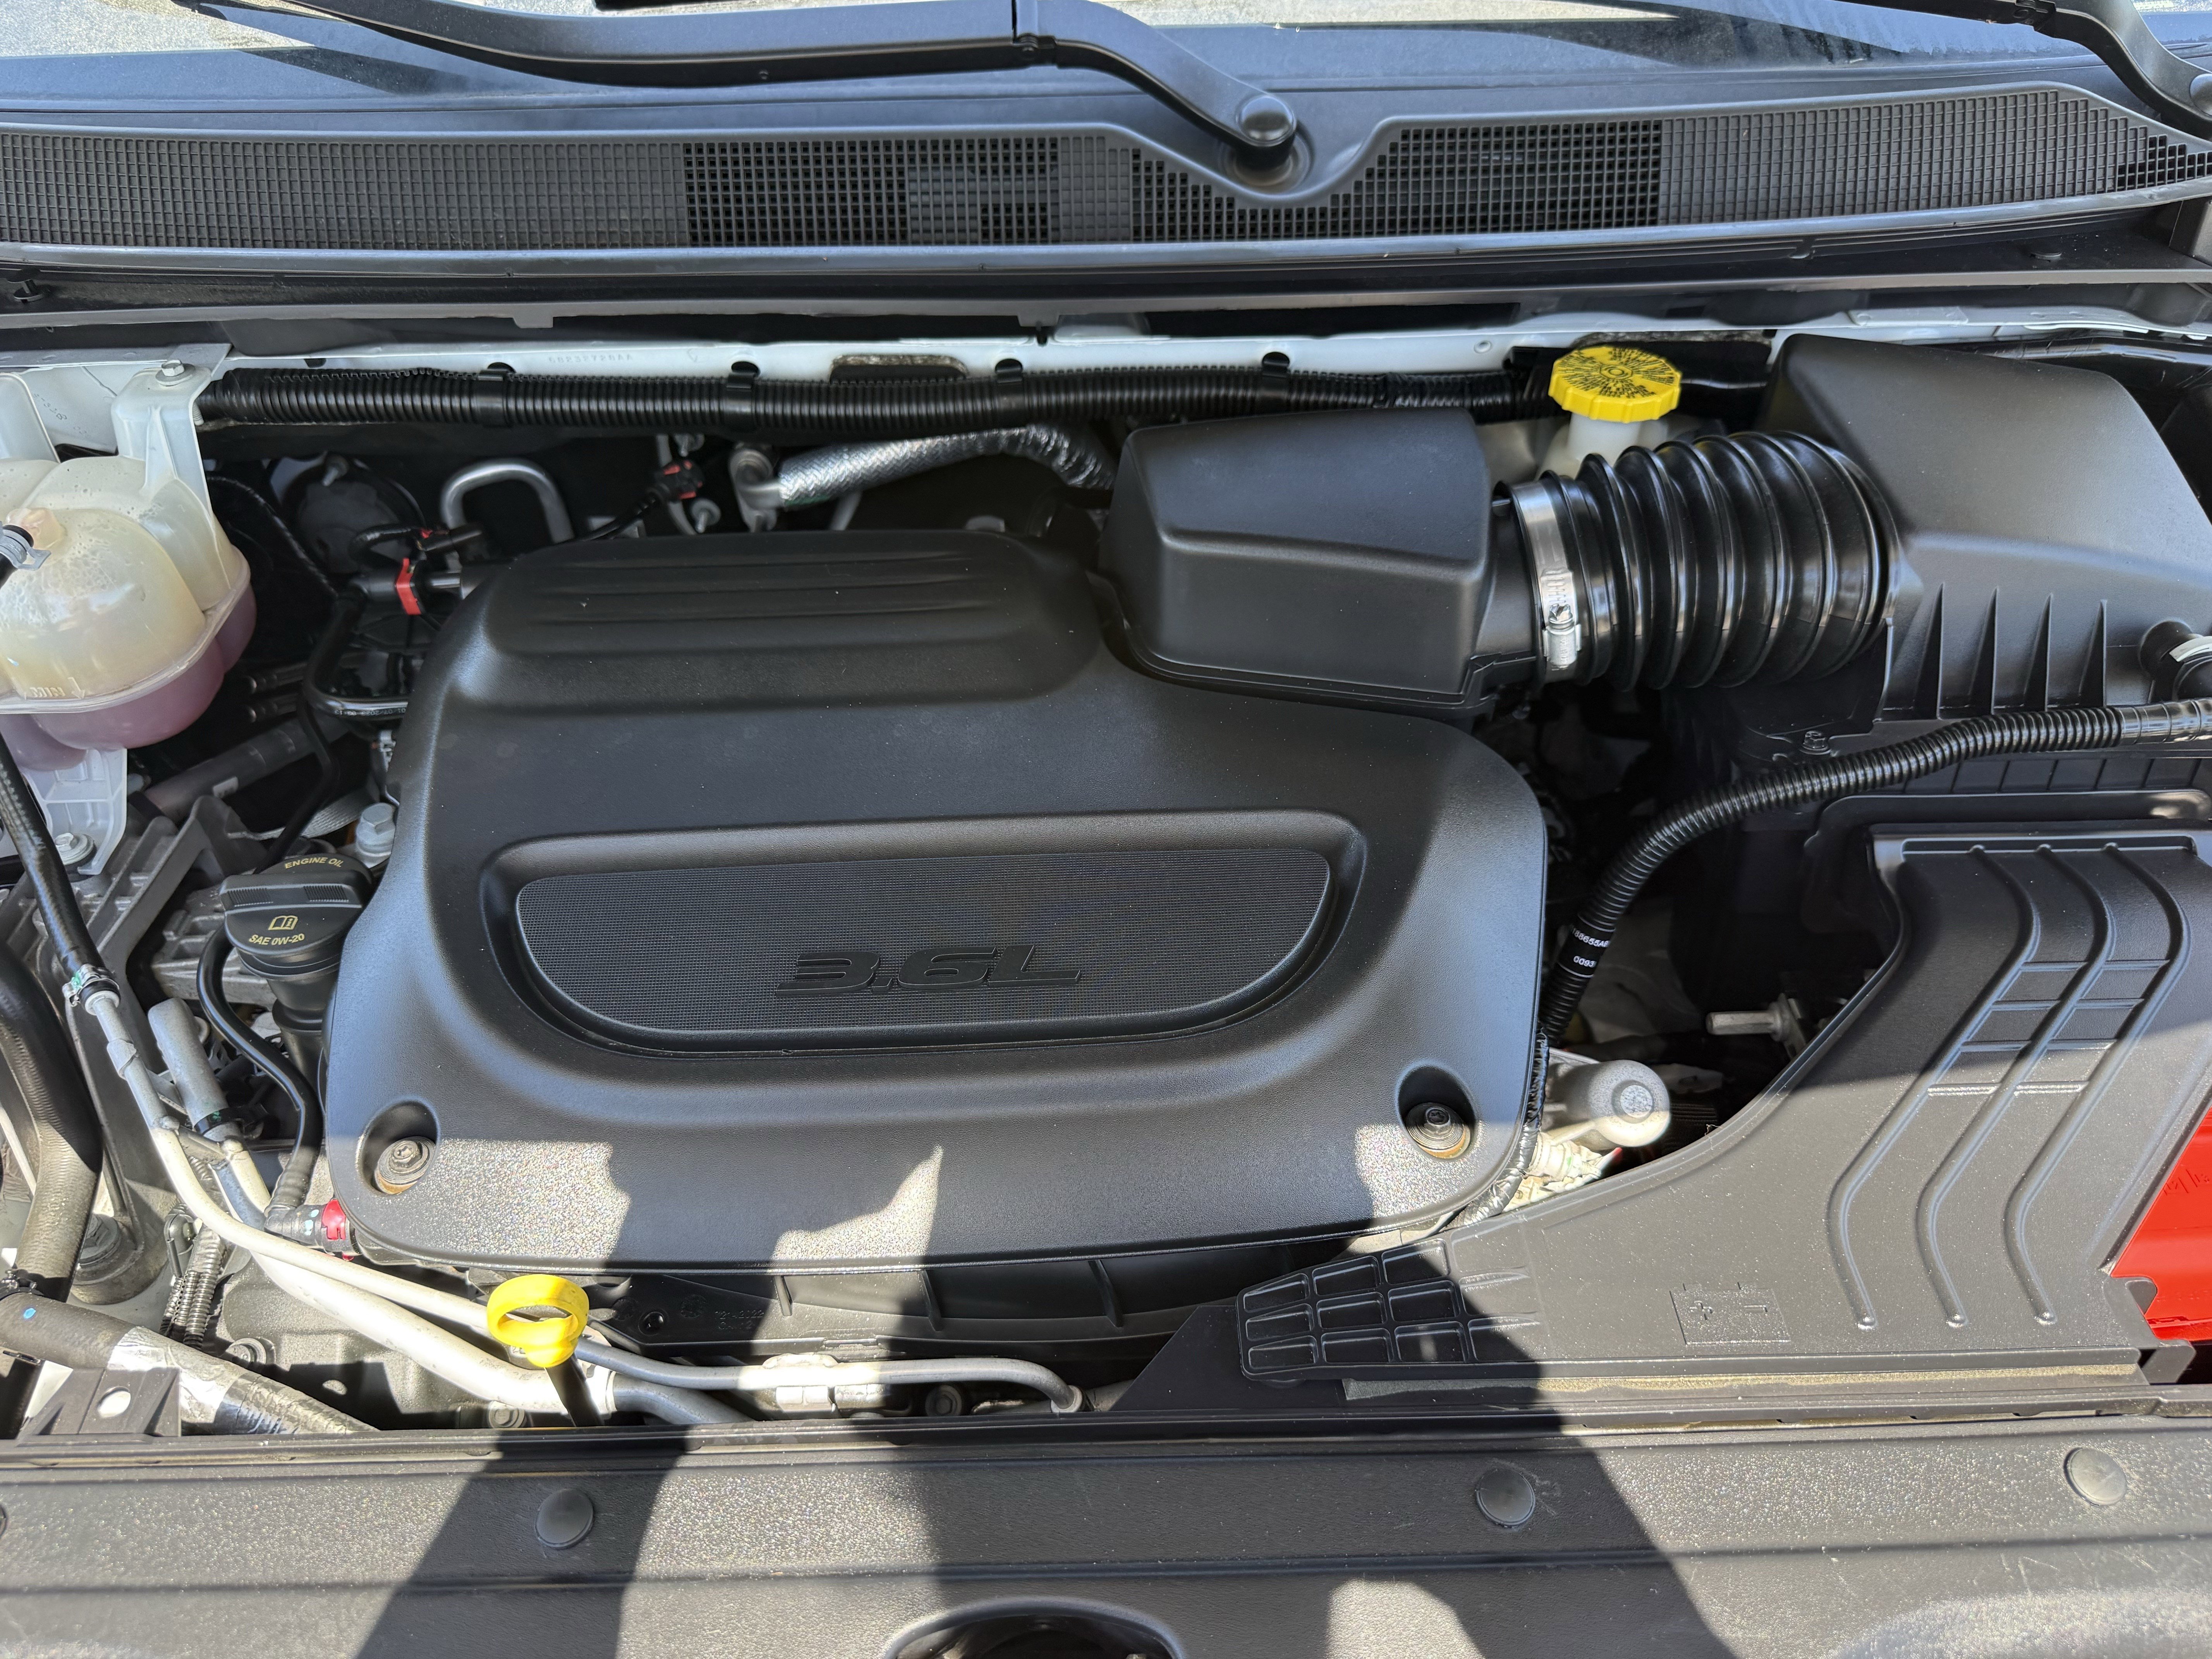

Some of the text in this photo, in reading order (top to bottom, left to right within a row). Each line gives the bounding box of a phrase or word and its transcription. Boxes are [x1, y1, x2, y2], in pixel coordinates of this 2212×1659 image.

[29, 687, 65, 697] MIN
[285, 857, 344, 869] ENGINE OIL
[249, 933, 305, 946] SAE 0W-20
[775, 944, 1082, 996] 3.6L
